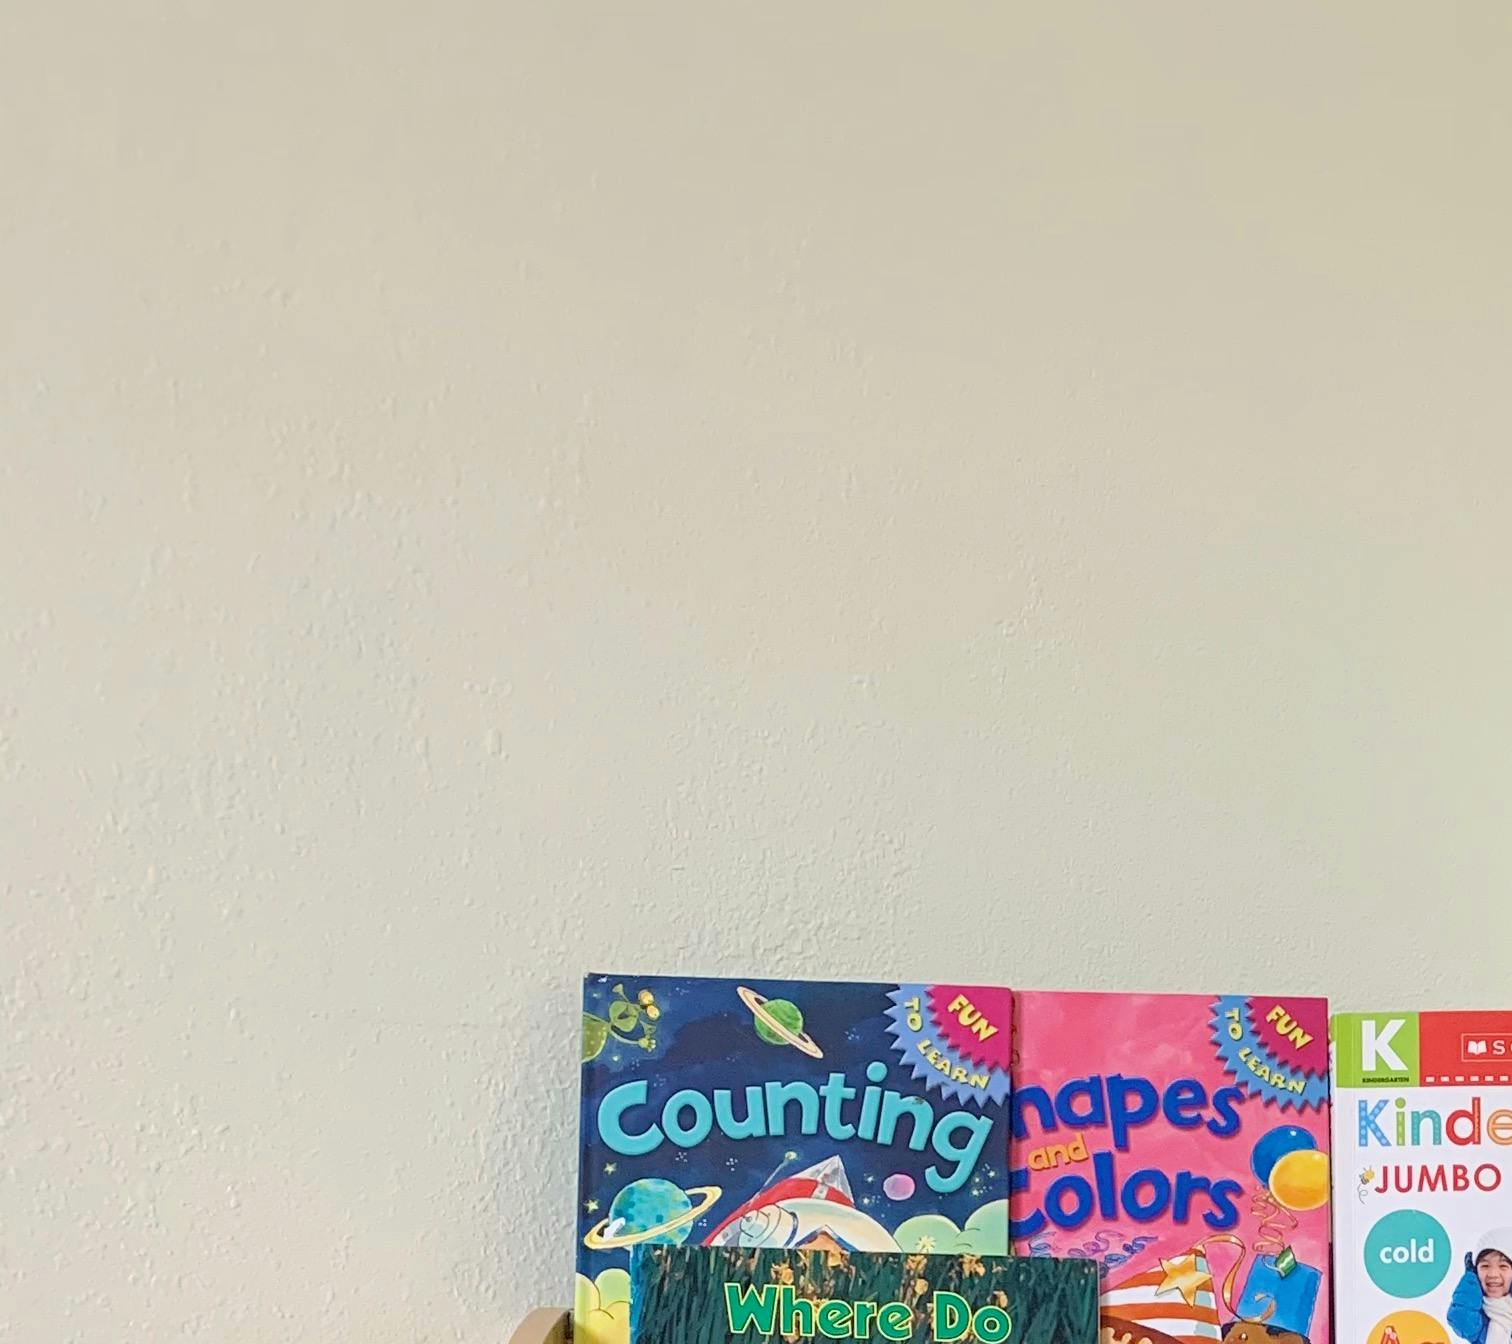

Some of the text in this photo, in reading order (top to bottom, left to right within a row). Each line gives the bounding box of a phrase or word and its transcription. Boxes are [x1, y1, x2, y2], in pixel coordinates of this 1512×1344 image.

[904, 997, 989, 1091] TO LEARN
[947, 994, 999, 1043] FUN
[1265, 1005, 1313, 1050] FUN
[1224, 1008, 1306, 1095] TO LEARN
[1361, 1019, 1408, 1072] K
[598, 1061, 994, 1193] Counting
[1009, 1073, 1245, 1149] hapes
[1028, 1133, 1088, 1171] and
[1373, 1163, 1502, 1194] JUMBO
[1379, 1238, 1435, 1265] cold
[723, 1282, 1012, 1344] Where Do
